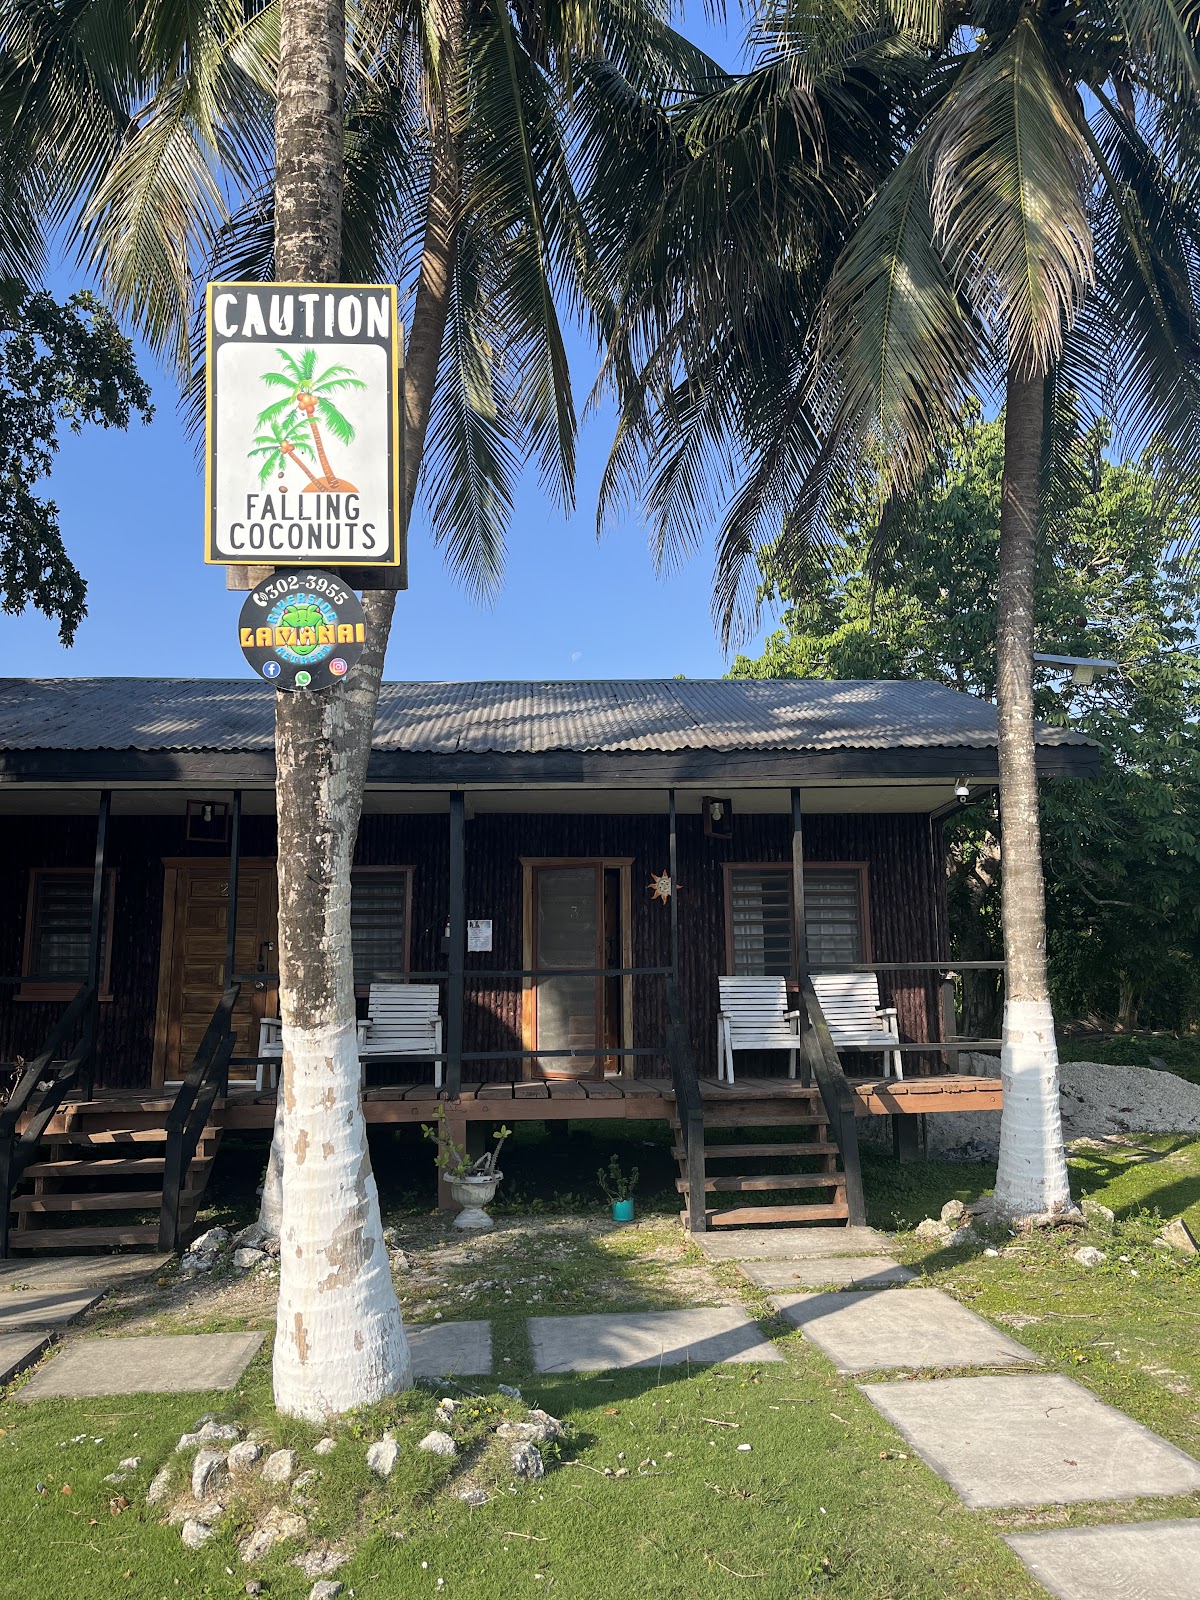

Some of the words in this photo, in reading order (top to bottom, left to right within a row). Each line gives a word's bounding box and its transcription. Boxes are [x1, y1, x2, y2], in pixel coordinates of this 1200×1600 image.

[214, 293, 389, 338] CAUTION
[247, 494, 360, 521] FALLING
[230, 522, 376, 550] COCONUTS
[265, 575, 349, 605] 302-3955
[267, 592, 337, 624] RIVERSIDE
[240, 623, 365, 648] LAMANAI
[220, 882, 229, 897] 2
[570, 905, 579, 919] 3
